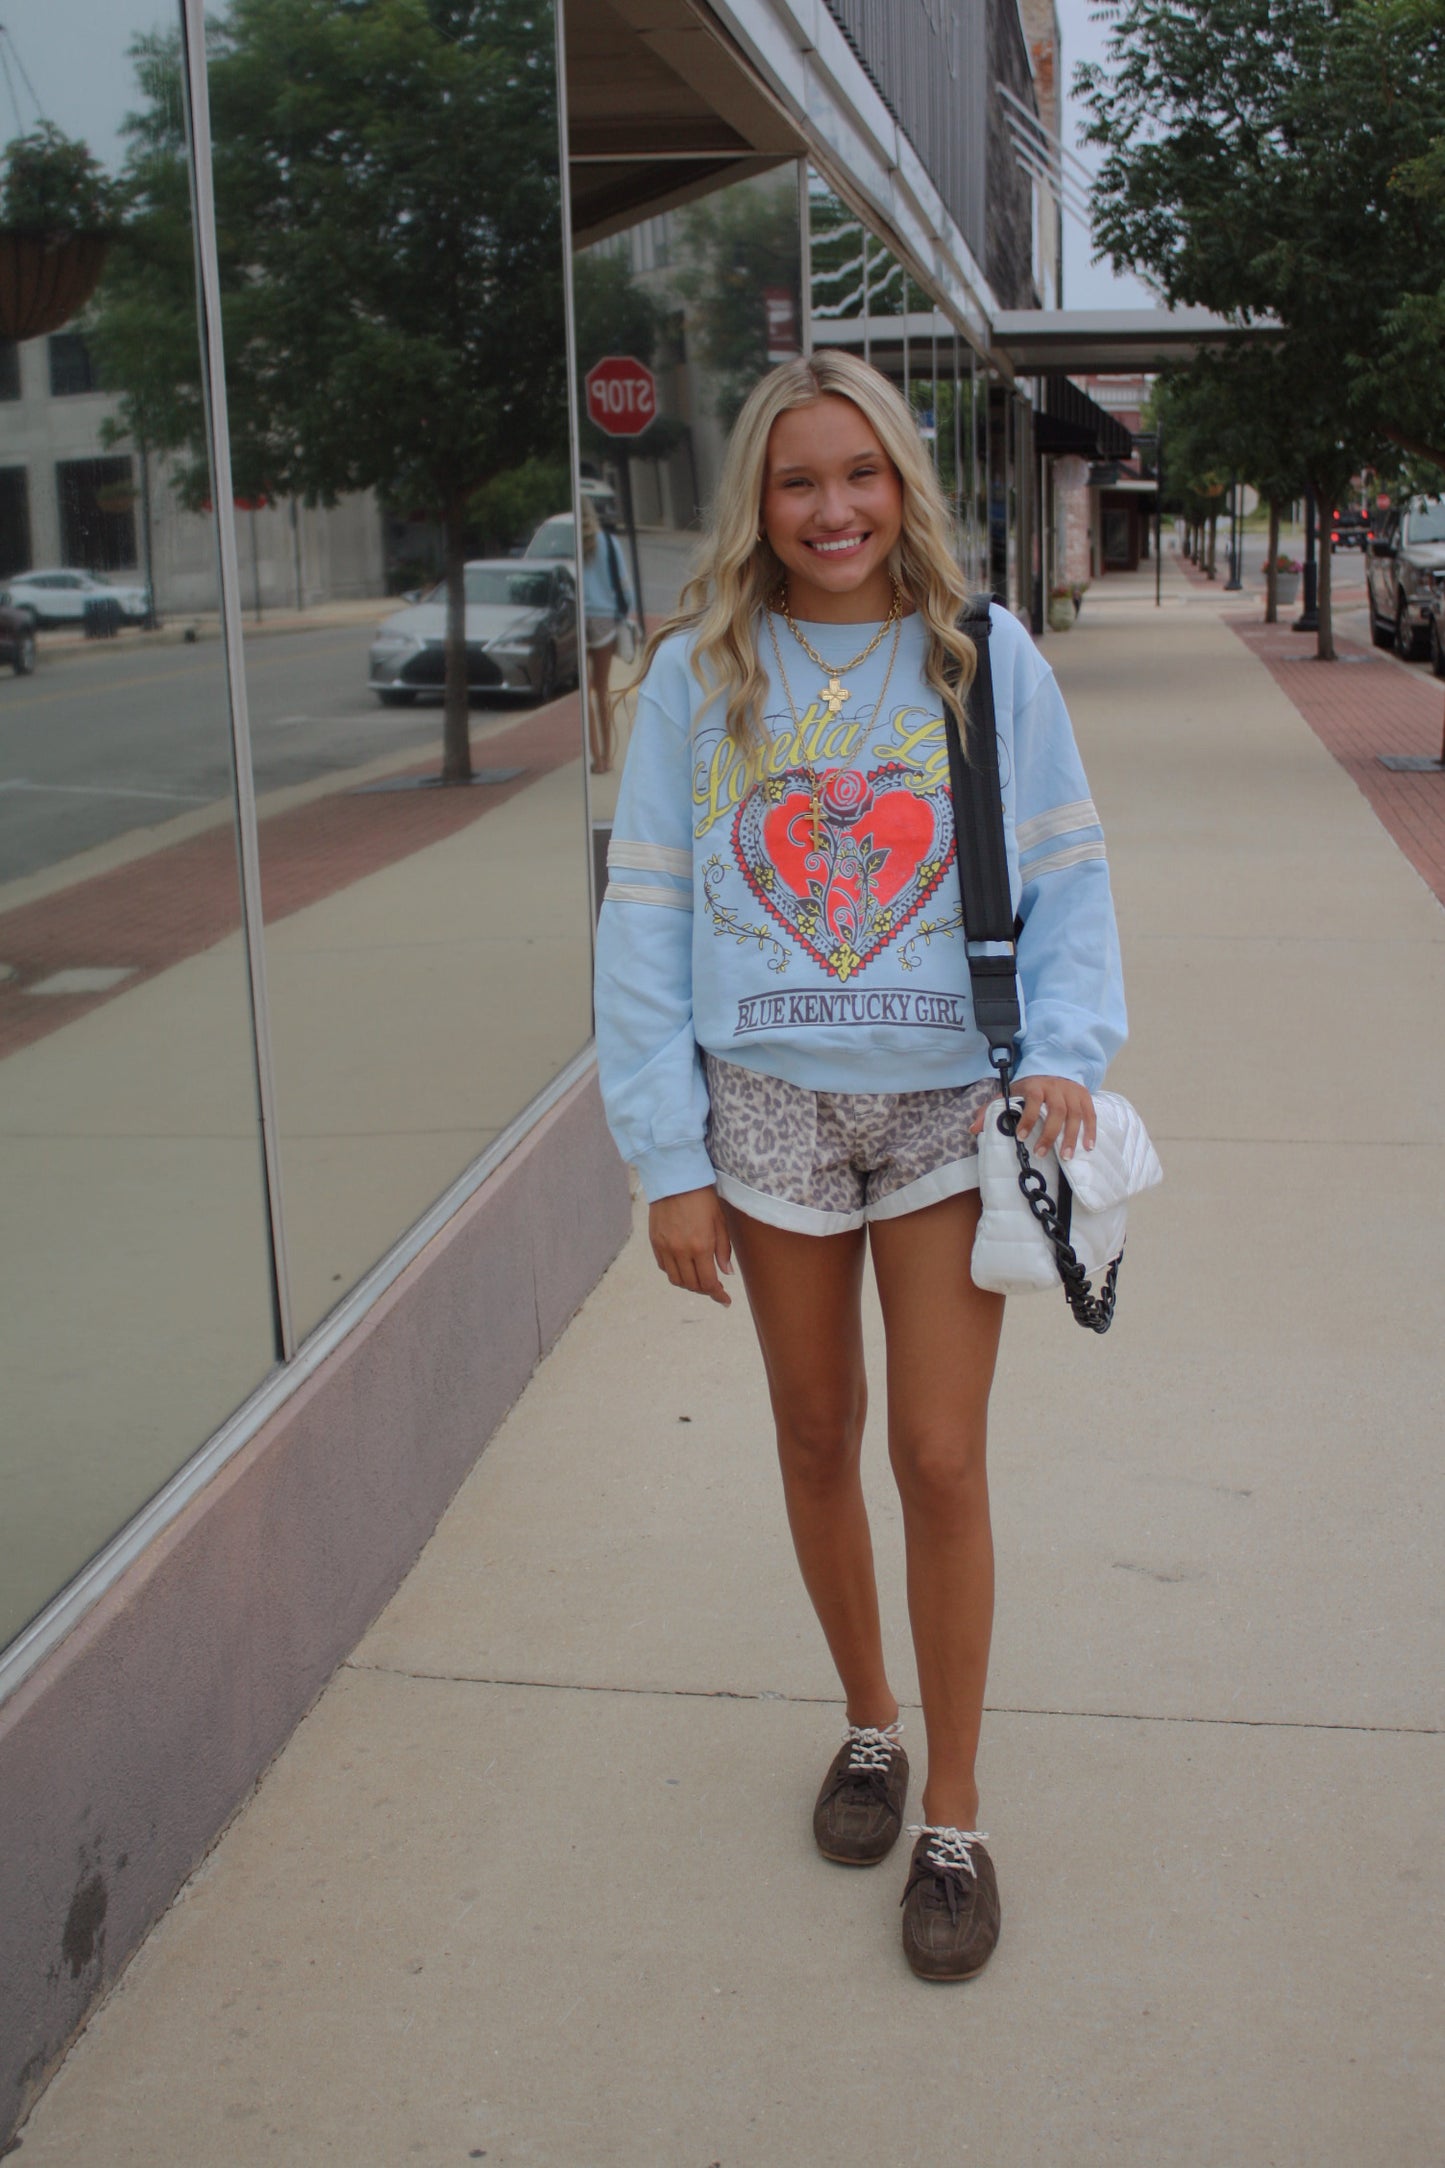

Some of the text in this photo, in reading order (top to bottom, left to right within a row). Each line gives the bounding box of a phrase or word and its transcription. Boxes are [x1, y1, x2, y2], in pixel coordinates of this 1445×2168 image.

[735, 993, 964, 1031] BLUE KENTUCKY GIRL
